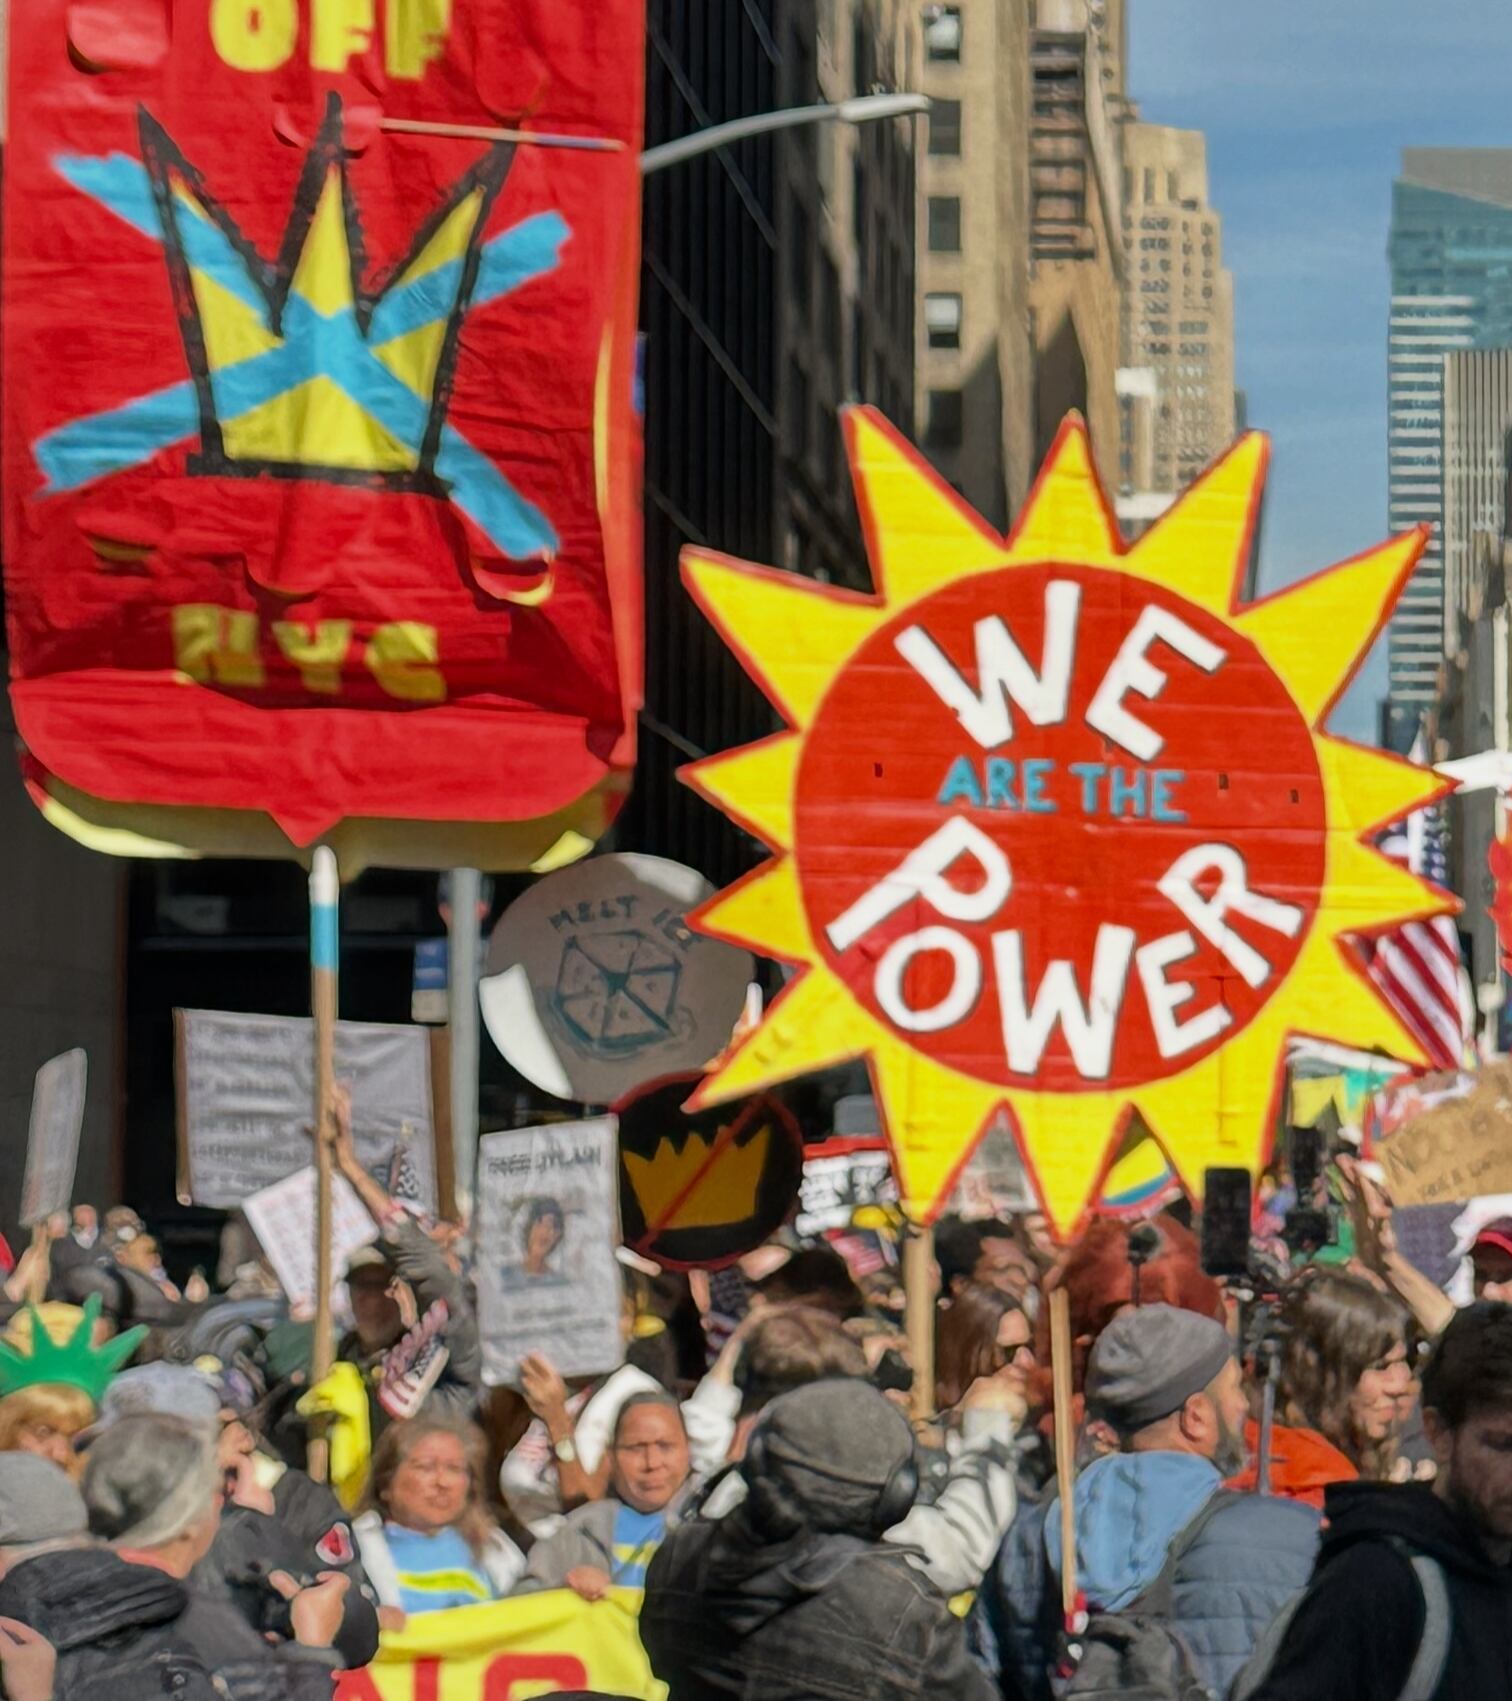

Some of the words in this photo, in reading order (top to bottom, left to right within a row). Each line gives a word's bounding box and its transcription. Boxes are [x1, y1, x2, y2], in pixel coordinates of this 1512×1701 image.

[209, 0, 450, 80] OFF
[893, 580, 1227, 763] WE
[937, 755, 1056, 812] ARE
[1068, 762, 1189, 822] THE
[825, 816, 1304, 1079] POWER
